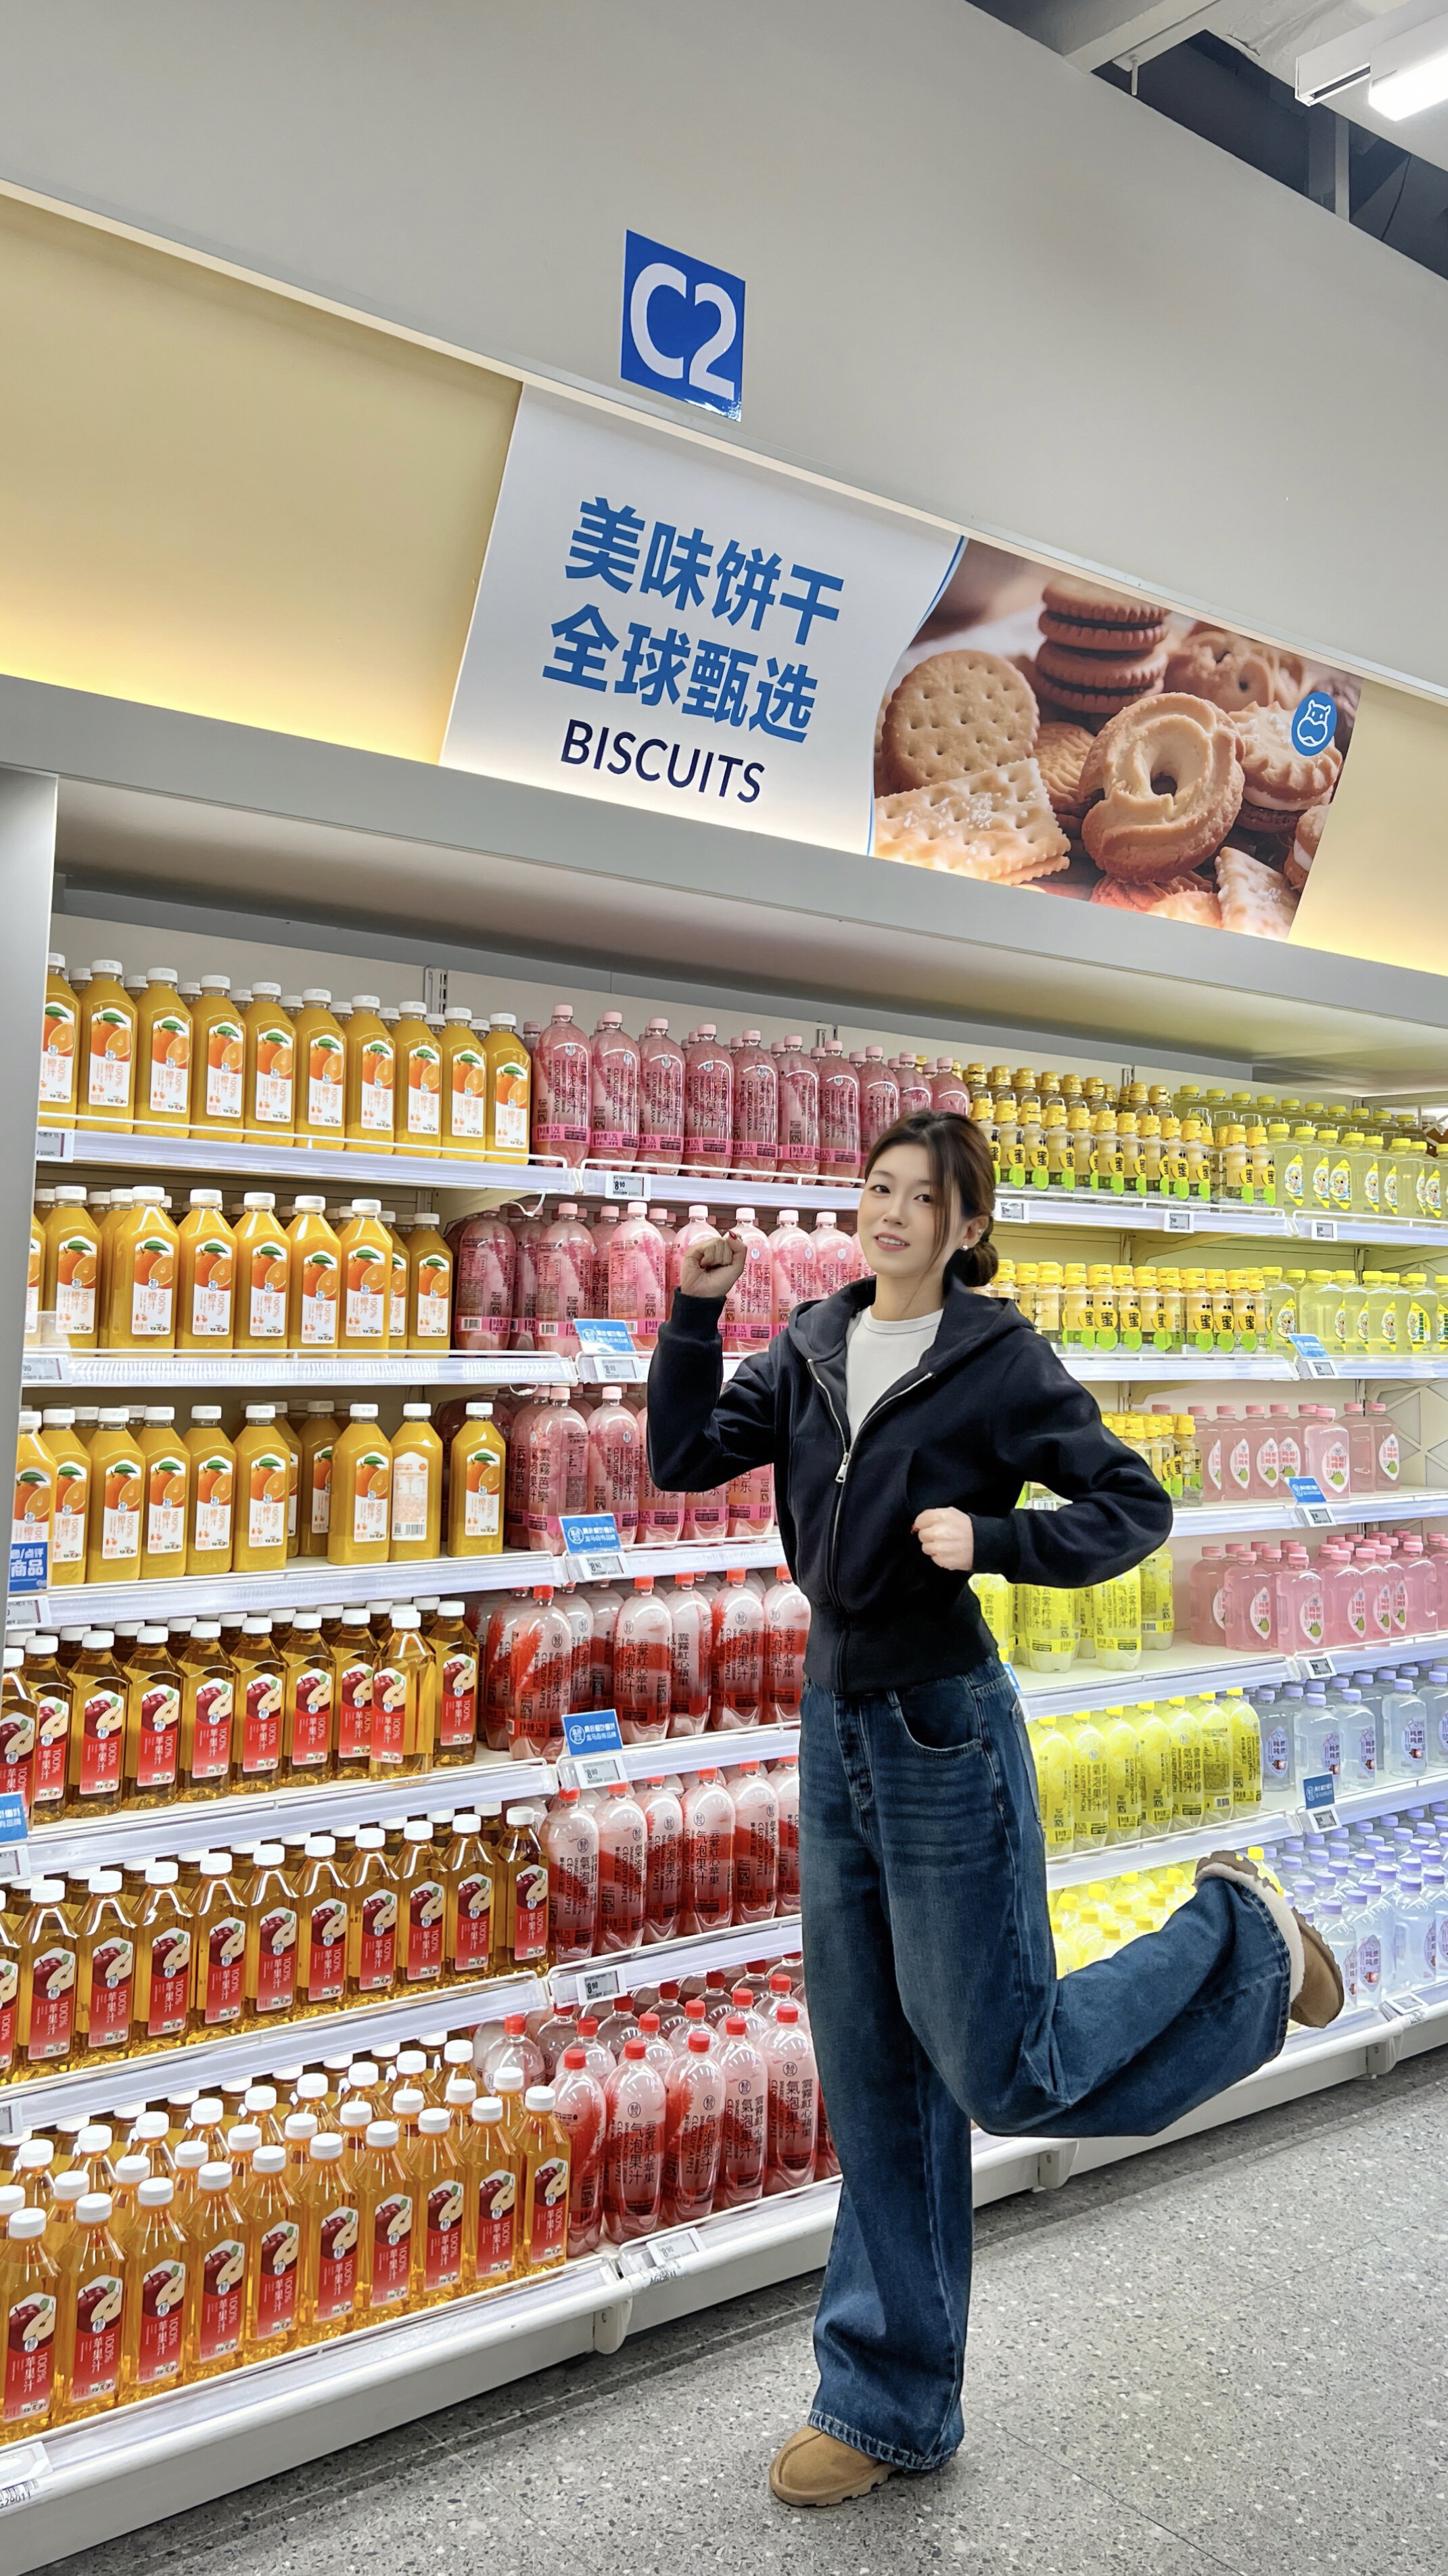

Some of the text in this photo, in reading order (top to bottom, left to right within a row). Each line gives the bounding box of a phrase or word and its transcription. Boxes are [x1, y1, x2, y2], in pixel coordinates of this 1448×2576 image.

[630, 262, 738, 401] C2
[565, 497, 845, 646] 美味饼干
[542, 603, 818, 743] 全球甄选
[561, 719, 765, 803] BISCUITS
[1102, 1312, 1114, 1327] 蜜
[1129, 1312, 1139, 1327] 蜜
[1200, 1315, 1211, 1330] 蜜
[1221, 1316, 1232, 1330] 蜜
[737, 1628, 749, 1682] 气泡果汁
[769, 1624, 783, 1678] 气泡果汁
[622, 1638, 636, 1694] 气泡果汁
[363, 1710, 371, 1732] 100%
[463, 1699, 471, 1722] 100%
[218, 1727, 228, 1751] 100%
[268, 1722, 277, 1745] 100%
[317, 1716, 326, 1739] 100%
[392, 1718, 400, 1739] 100%
[108, 1741, 117, 1766] 100%
[164, 1734, 173, 1759] 100%
[53, 1749, 61, 1773] 100%
[695, 1830, 708, 1885] 气泡果汁
[708, 1830, 720, 1886] 云雾红心苹果
[431, 1929, 439, 1953] 100%
[479, 1921, 487, 1945] 100%
[333, 1948, 342, 1973] 100%
[384, 1938, 392, 1962] 100%
[231, 1968, 240, 1993] 100%
[282, 1957, 291, 1982] 100%
[118, 1990, 127, 2016] 100%
[174, 1979, 185, 2004] 100%
[1, 2013, 11, 2040] 100%
[58, 2001, 69, 2028] 100%
[785, 2081, 800, 2140] 氣泡果汁
[739, 2098, 753, 2160] 氣泡果汁
[628, 2122, 644, 2186] 气泡果汁
[644, 2120, 657, 2184] 云雾红心苹果
[699, 2115, 716, 2175] 气泡果汁
[555, 2207, 563, 2232] 100%
[450, 2232, 458, 2257] 100%
[502, 2221, 511, 2247] 100%
[344, 2259, 352, 2286] 100%
[398, 2247, 407, 2273] 100%
[284, 2276, 293, 2303] 100%
[228, 2296, 239, 2324] 100%
[168, 2317, 179, 2346] 100%
[103, 2334, 115, 2364] 100%
[36, 2351, 47, 2383] 100%
